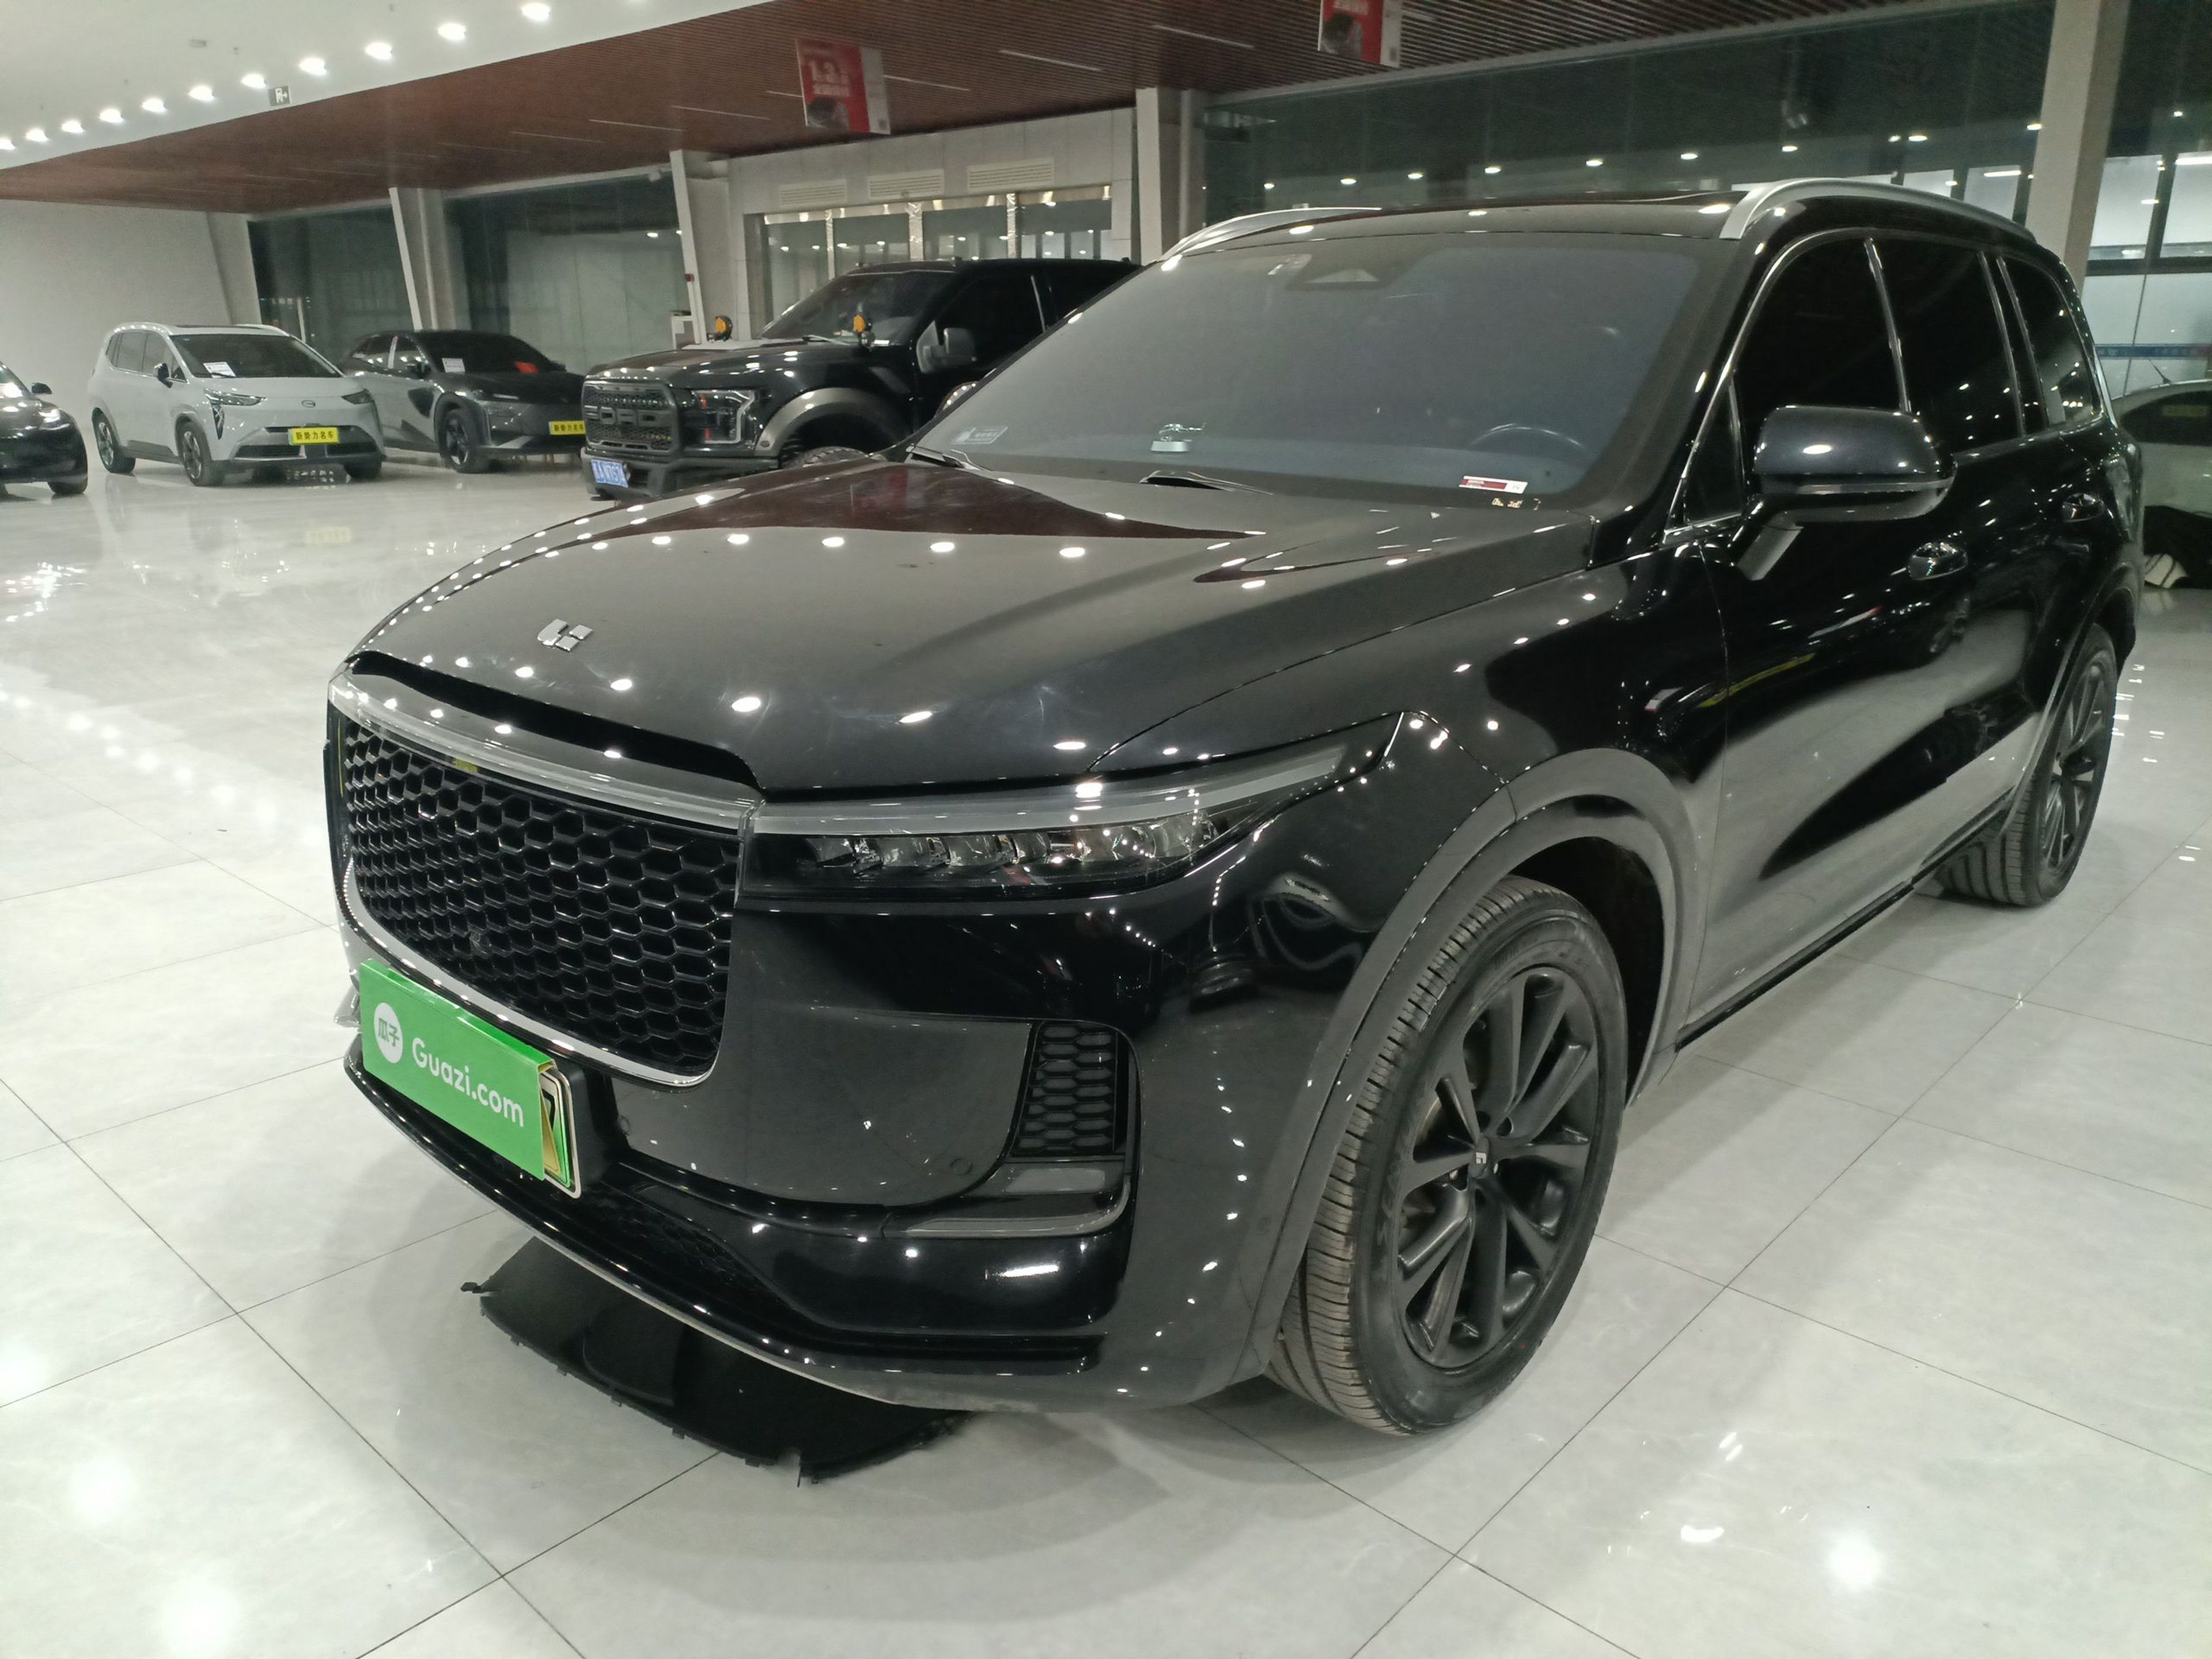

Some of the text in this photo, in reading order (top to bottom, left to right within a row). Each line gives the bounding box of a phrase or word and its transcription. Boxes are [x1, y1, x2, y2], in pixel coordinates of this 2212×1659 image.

[296, 431, 334, 440] 新势力名车
[378, 1017, 400, 1047] 瓜子
[412, 1037, 524, 1127] Guazi.com
